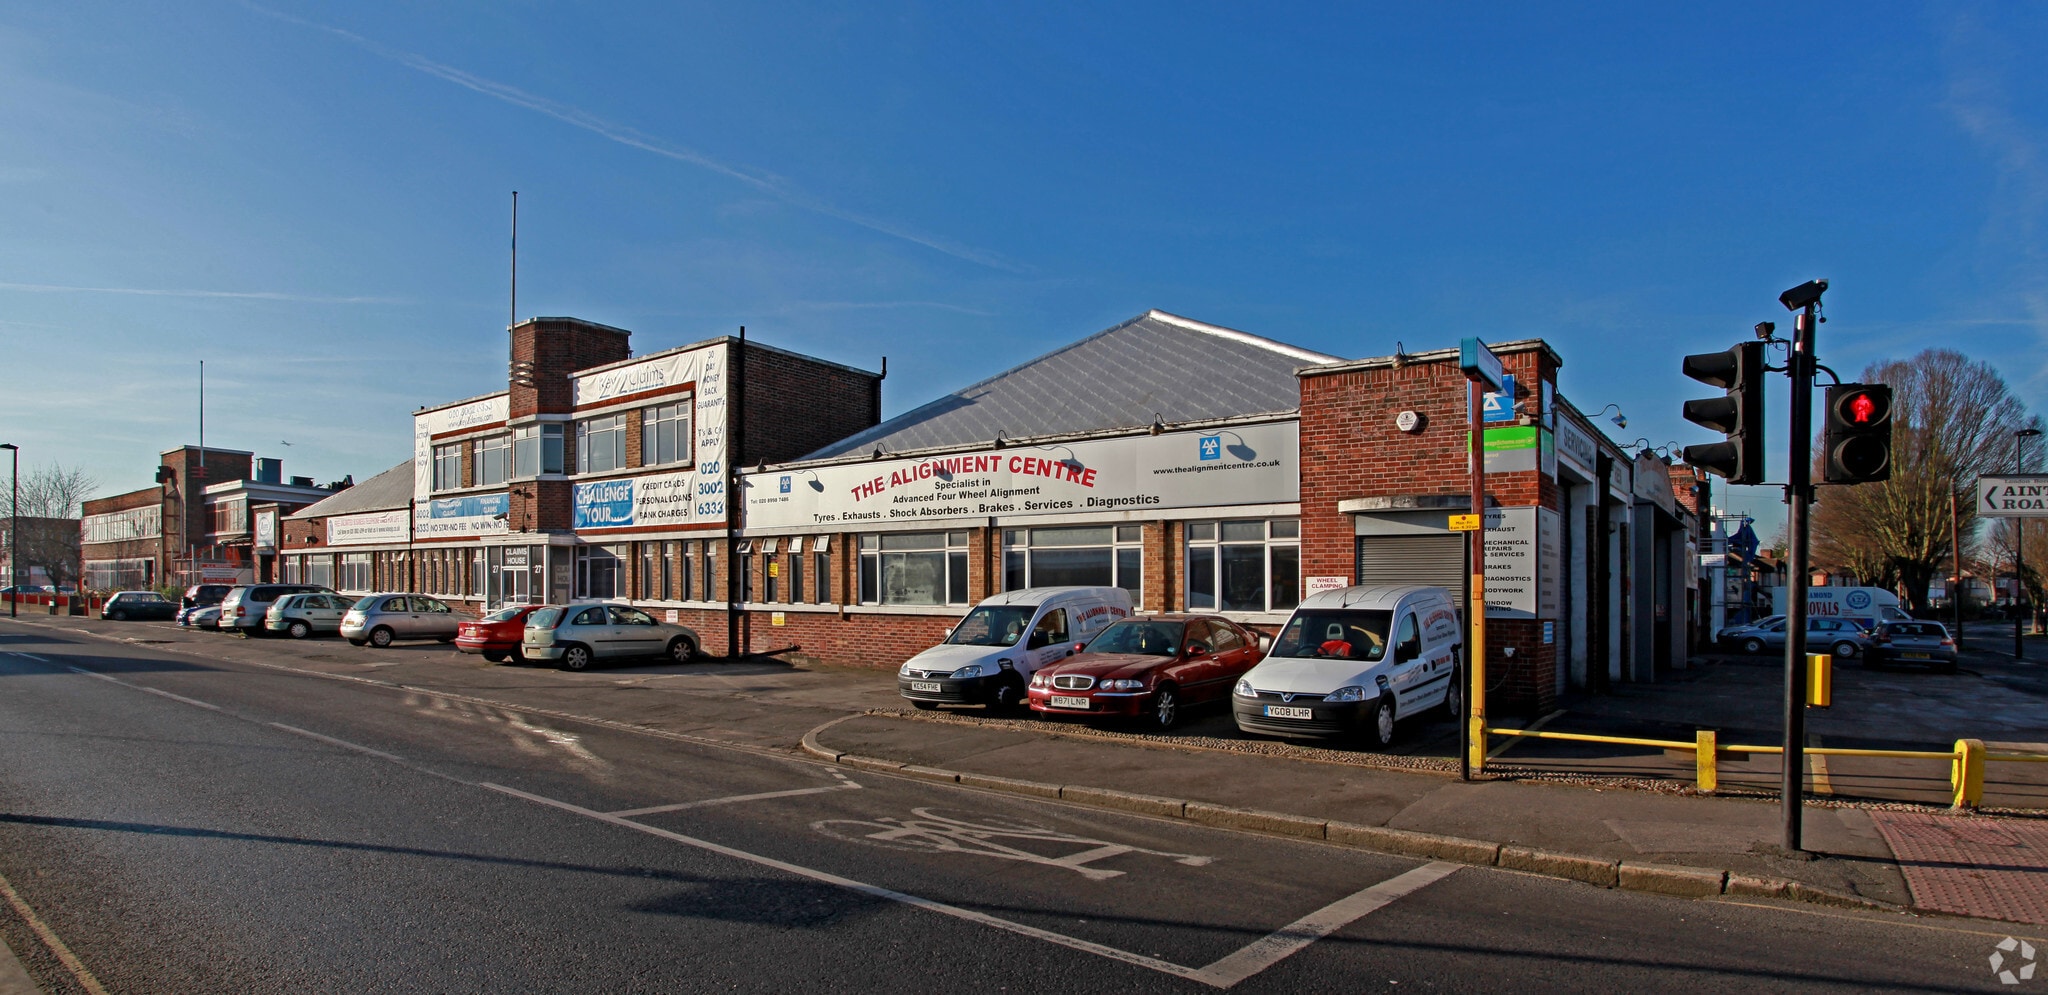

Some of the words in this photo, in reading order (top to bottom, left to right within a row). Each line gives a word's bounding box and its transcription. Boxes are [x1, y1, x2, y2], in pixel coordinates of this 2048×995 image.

[629, 365, 664, 386] Claims
[702, 438, 720, 448] APPLY
[701, 461, 720, 474] 020
[1153, 460, 1280, 475] www.thealignmentcentre.co.uk
[851, 476, 885, 502] THE
[890, 455, 1002, 488] ALIGNMENT
[1008, 455, 1098, 488] CENTRE
[642, 482, 662, 490] CREDIT
[664, 480, 685, 488] CARDS
[699, 481, 724, 494] 3002
[935, 479, 979, 492] Specialist
[982, 478, 991, 486] in
[577, 485, 629, 504] CHALLENGE
[636, 496, 668, 506] PERSONAL
[669, 494, 692, 502] LOANS
[892, 493, 934, 504] Advanced
[937, 492, 956, 501] Four
[958, 489, 987, 500] Wheel
[990, 486, 1040, 498] Alignment
[698, 501, 724, 515] 6333
[813, 513, 835, 524] Tyres
[842, 510, 880, 520] Exhausts
[890, 508, 918, 518] Shock
[920, 505, 968, 516] Absorbers
[978, 502, 1014, 513] Brakes
[1024, 499, 1073, 510] Services
[1087, 494, 1160, 508] Diagnostics
[2002, 499, 2048, 509] ROA
[416, 509, 430, 518] 3002
[640, 511, 657, 519] BANK
[658, 508, 688, 518] CHARGES
[459, 522, 467, 530] FEE
[471, 522, 479, 530] NO
[506, 548, 527, 556] CLAIMS
[493, 565, 499, 573] 27
[535, 565, 541, 573] 27
[1807, 602, 1839, 616] OVALS
[1270, 707, 1290, 716] YG08
[1292, 709, 1310, 717] LHR
